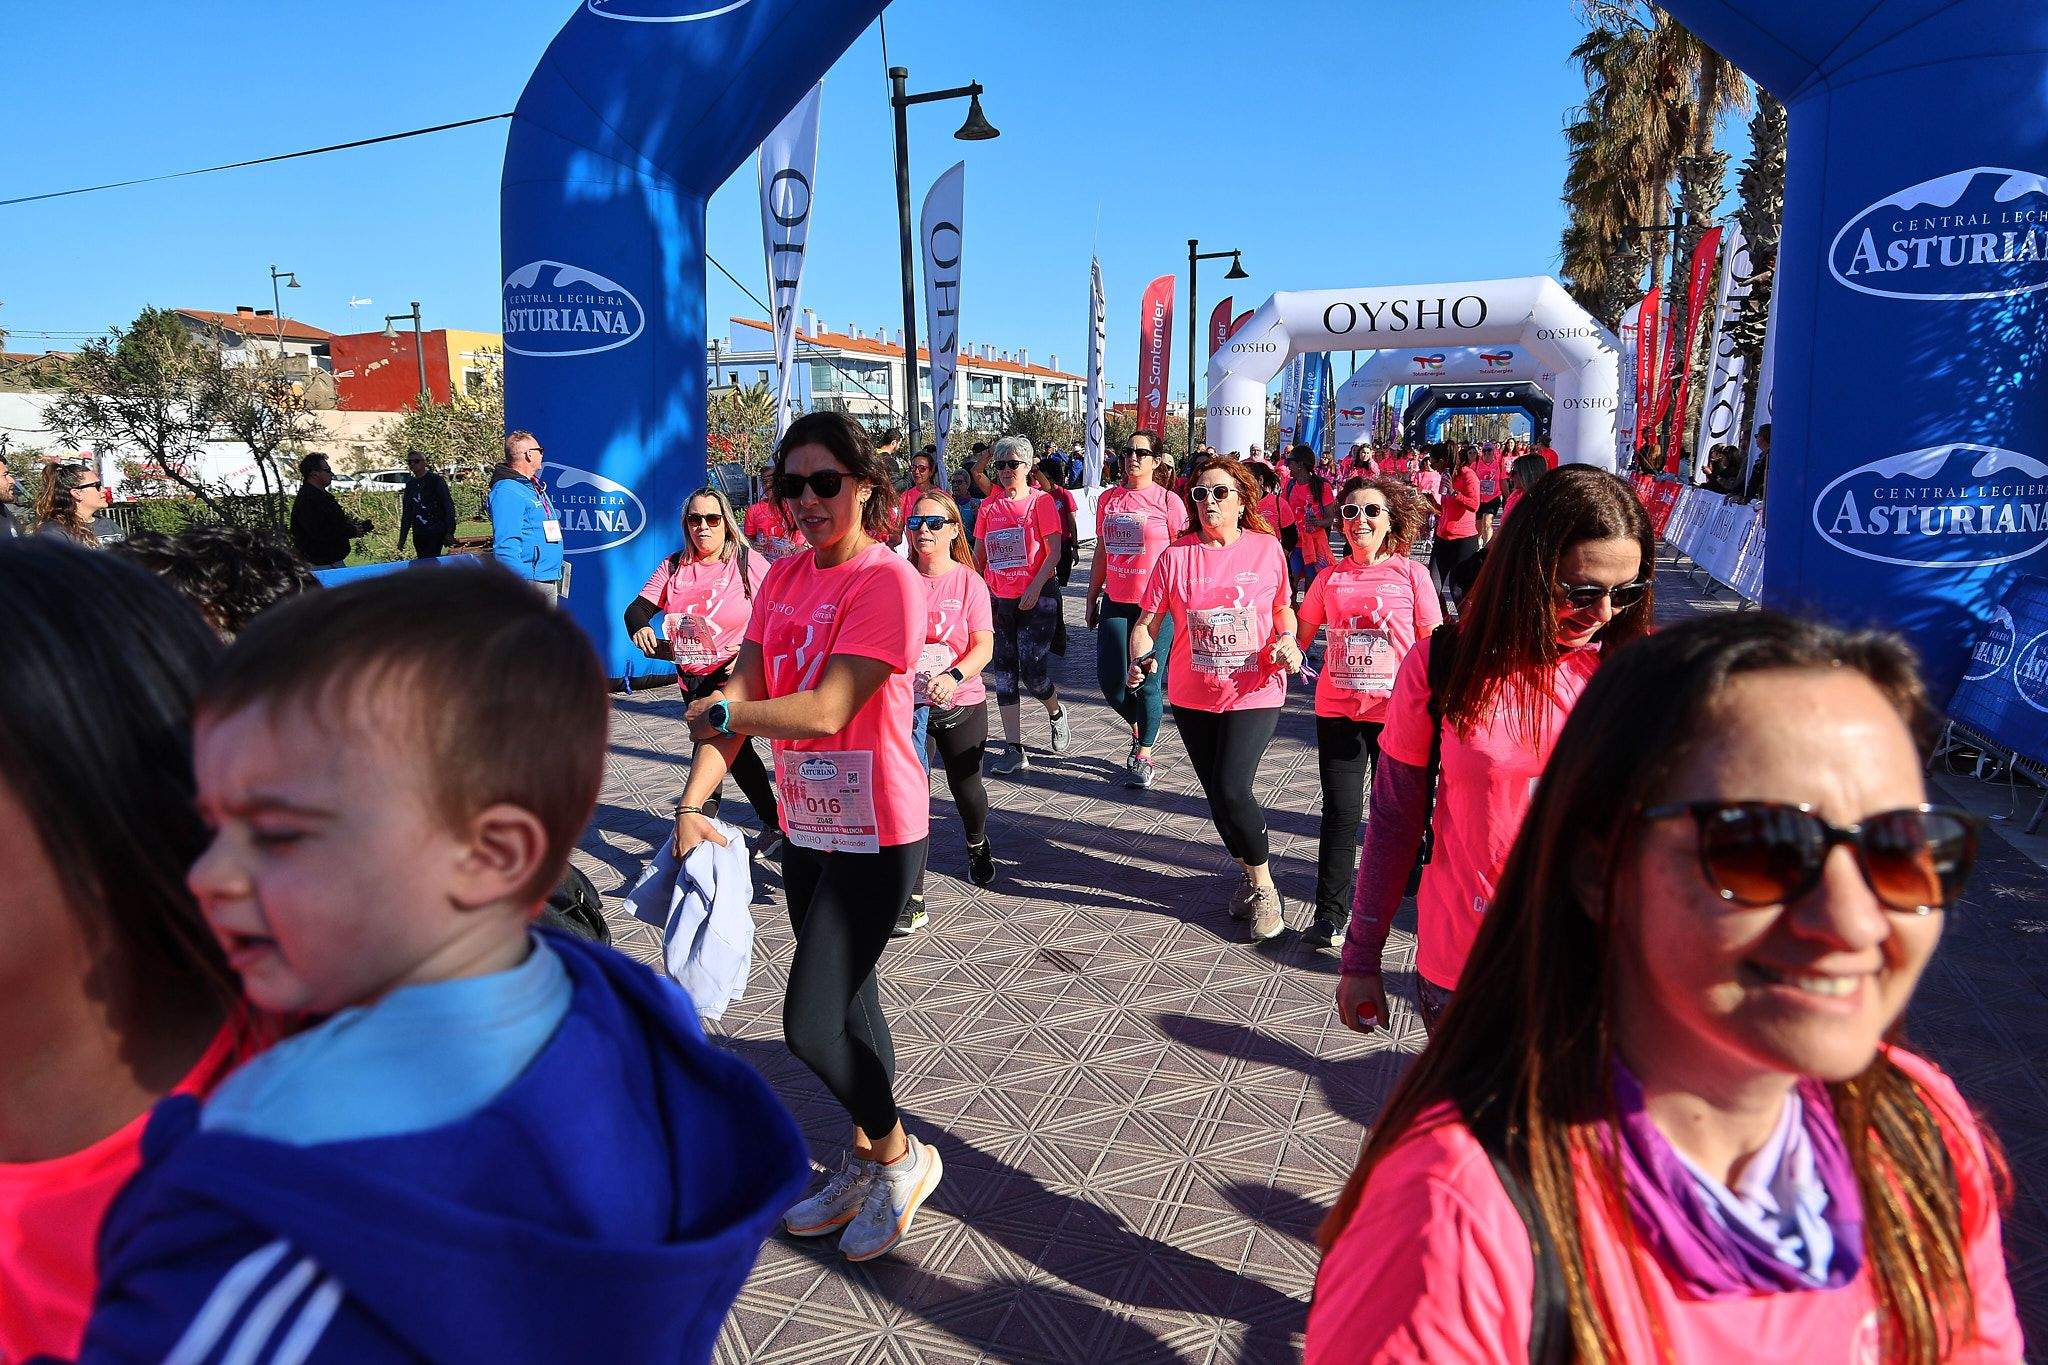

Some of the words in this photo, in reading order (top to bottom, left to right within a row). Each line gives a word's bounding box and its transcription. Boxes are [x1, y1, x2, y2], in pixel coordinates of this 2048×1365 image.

[1893, 213, 1991, 233] CENTRAL
[1845, 227, 2048, 276] ASTURIA
[510, 294, 553, 304] CENTRAL
[559, 294, 623, 306] LECHERA
[1323, 295, 1488, 335] OYSHO
[1536, 327, 1591, 341] OYSHO
[1149, 299, 1165, 386] Santander
[1231, 342, 1277, 353] OYSHO
[1643, 313, 1652, 387] Santander
[1444, 391, 1515, 400] VOLVO
[1563, 397, 1613, 410] OYSHO
[1210, 405, 1252, 417] OYSHO
[1873, 487, 1969, 499] CENTRAL
[562, 495, 625, 505] LECHERA
[1116, 530, 1132, 538] 016
[1000, 545, 1014, 554] 016
[682, 635, 701, 645] 016
[1211, 634, 1237, 645] 016
[1347, 655, 1373, 666] 016
[1190, 664, 1216, 674] CARRERA
[806, 797, 842, 814] 016
[815, 816, 834, 825] 2048
